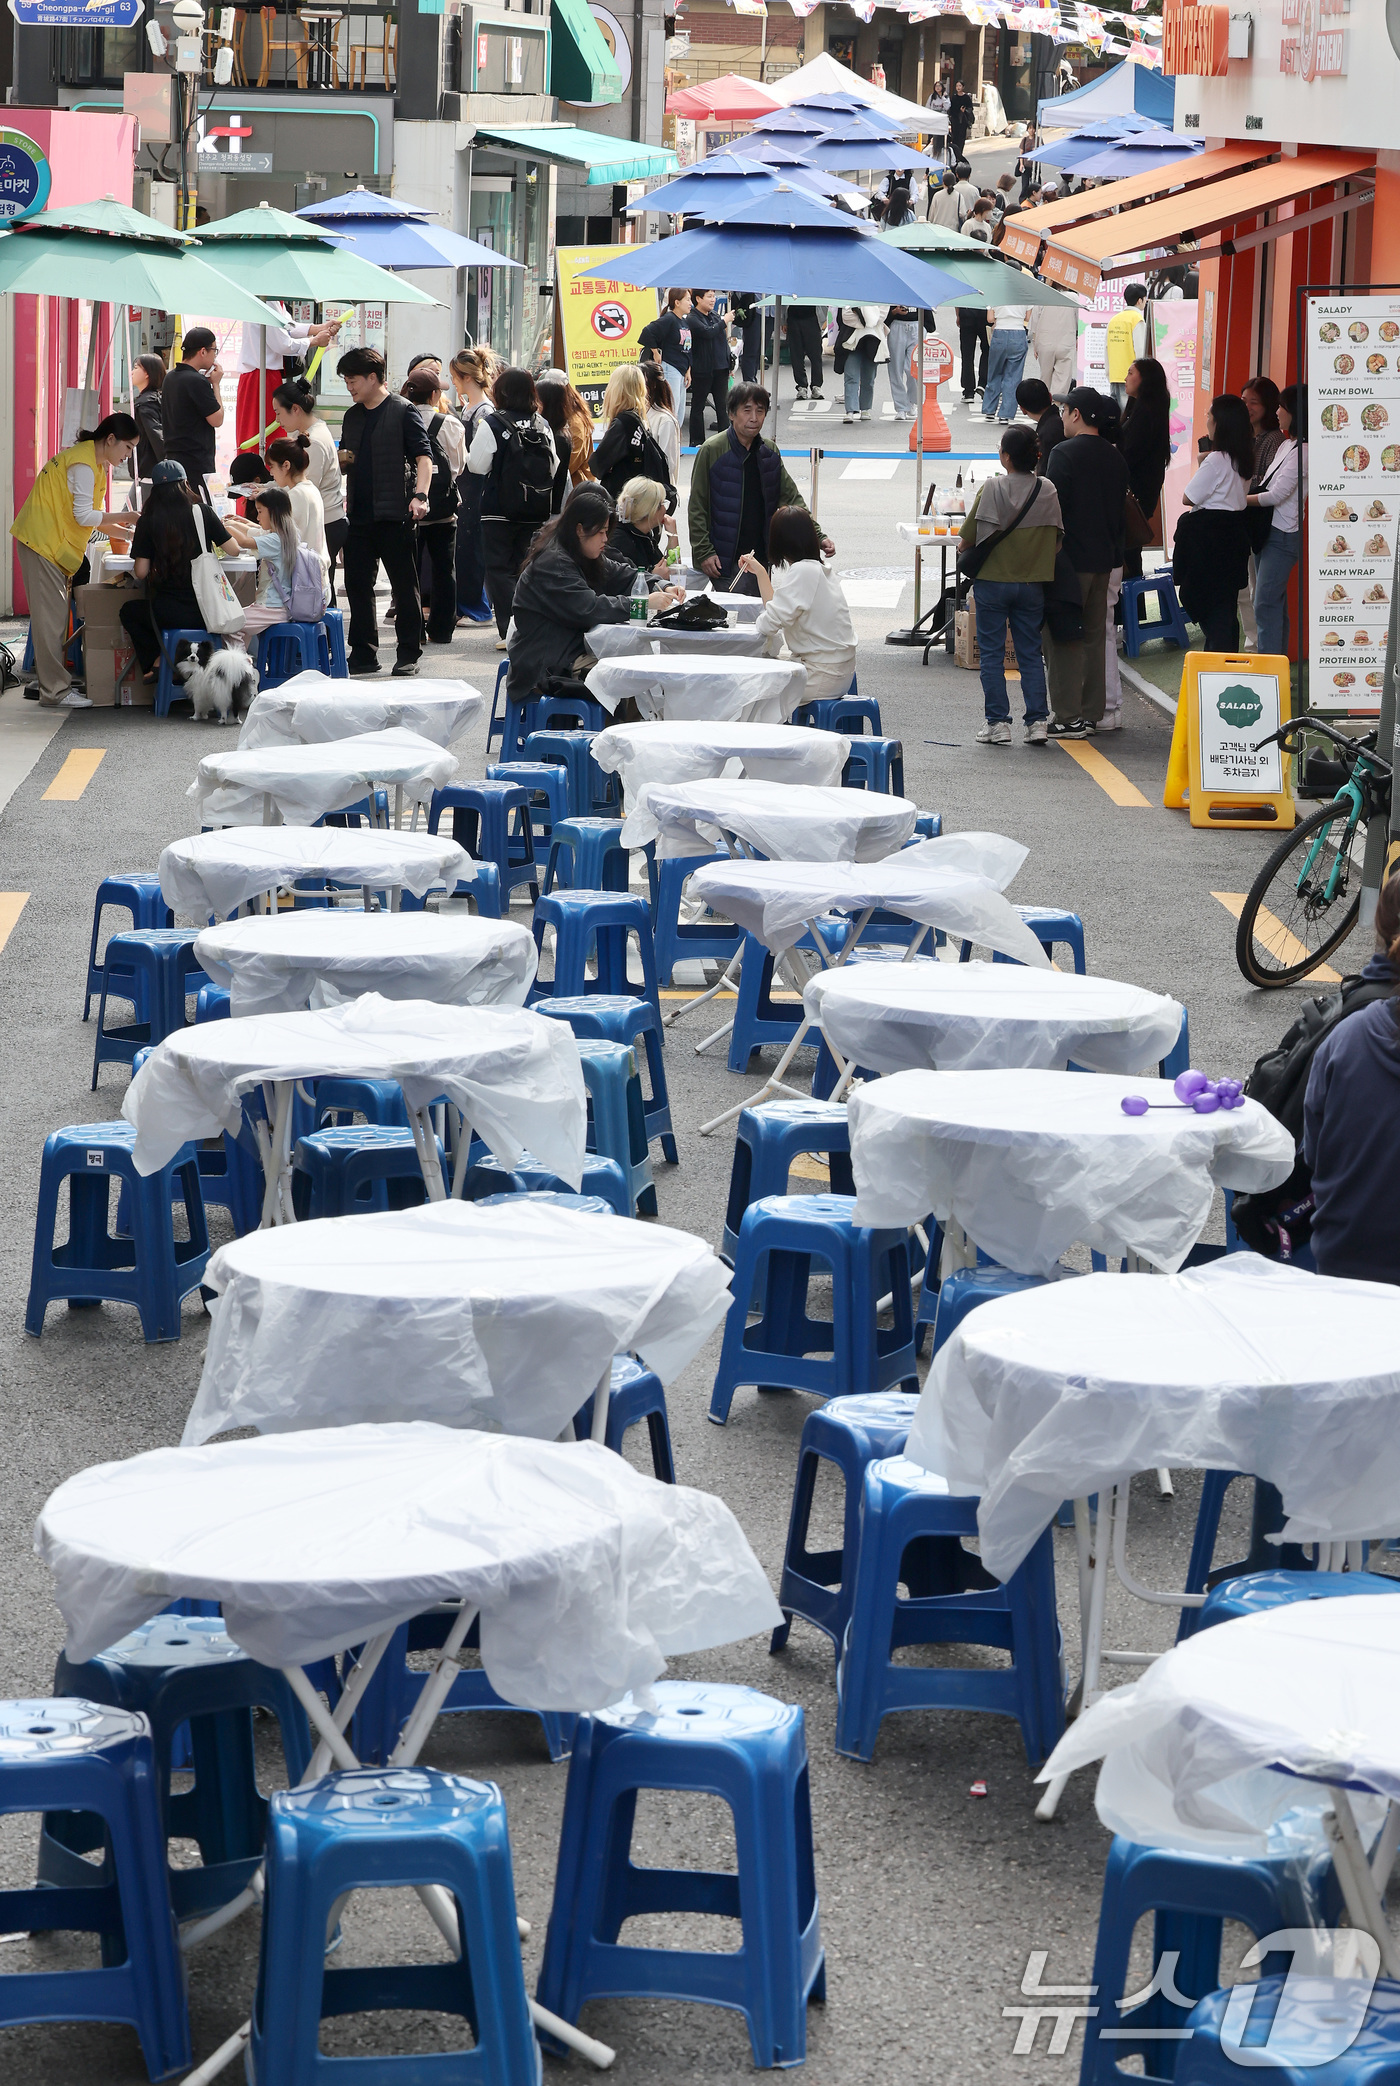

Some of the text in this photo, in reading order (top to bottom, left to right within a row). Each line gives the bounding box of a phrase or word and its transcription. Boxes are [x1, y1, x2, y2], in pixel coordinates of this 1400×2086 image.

[120, 2, 132, 11] 63
[1315, 33, 1344, 72] FRIEND
[196, 113, 253, 153] kt
[14, 136, 37, 155] STORE
[570, 280, 619, 296] 교통통제
[1318, 306, 1352, 314] SALADY
[367, 321, 382, 329] 할인
[571, 349, 597, 359] (청파로
[621, 348, 637, 357] 나길
[1318, 387, 1374, 396] WARM BOWL
[1318, 568, 1347, 576] WARM
[1319, 615, 1355, 623] BURGER
[1219, 702, 1260, 710] SALADY
[1219, 742, 1247, 752] 고객님
[1210, 755, 1269, 765] 배달기사님 외
[1223, 767, 1260, 777] 주차금지
[1293, 1200, 1311, 1214] FILA
